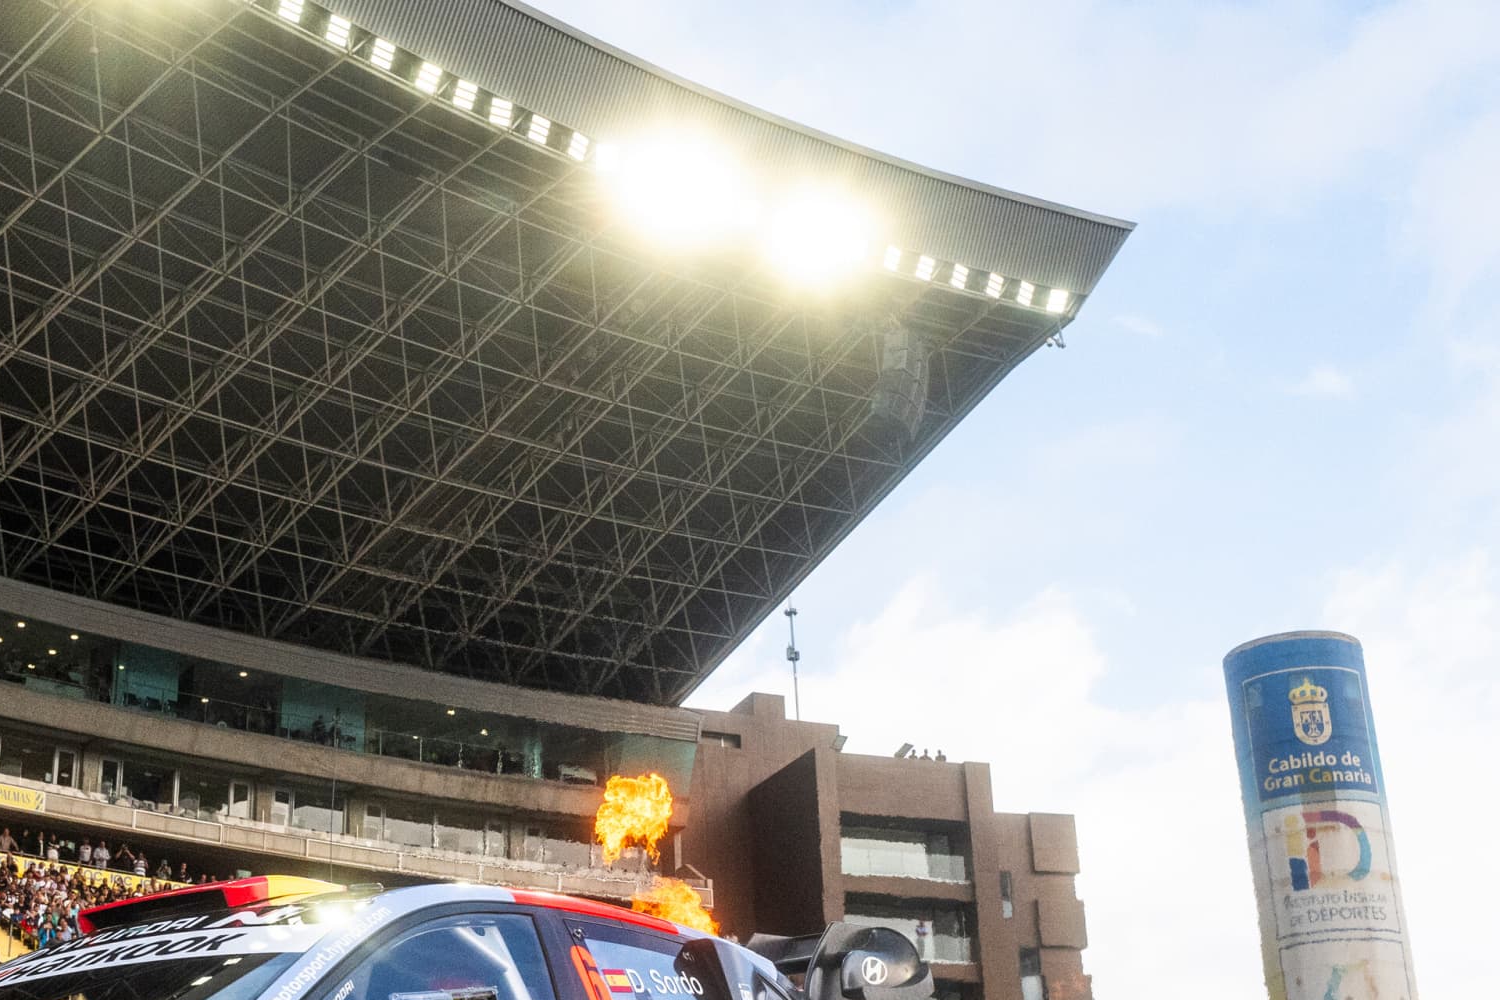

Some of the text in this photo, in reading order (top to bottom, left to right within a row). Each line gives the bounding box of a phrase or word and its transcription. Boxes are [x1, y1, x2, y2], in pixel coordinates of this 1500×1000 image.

[1268, 750, 1361, 774] Cabildo de
[1264, 768, 1372, 792] Gran Canaria
[1307, 904, 1388, 924] DEPORTES
[50, 915, 210, 953] HYUNDAI
[626, 968, 703, 996] D. Sordo
